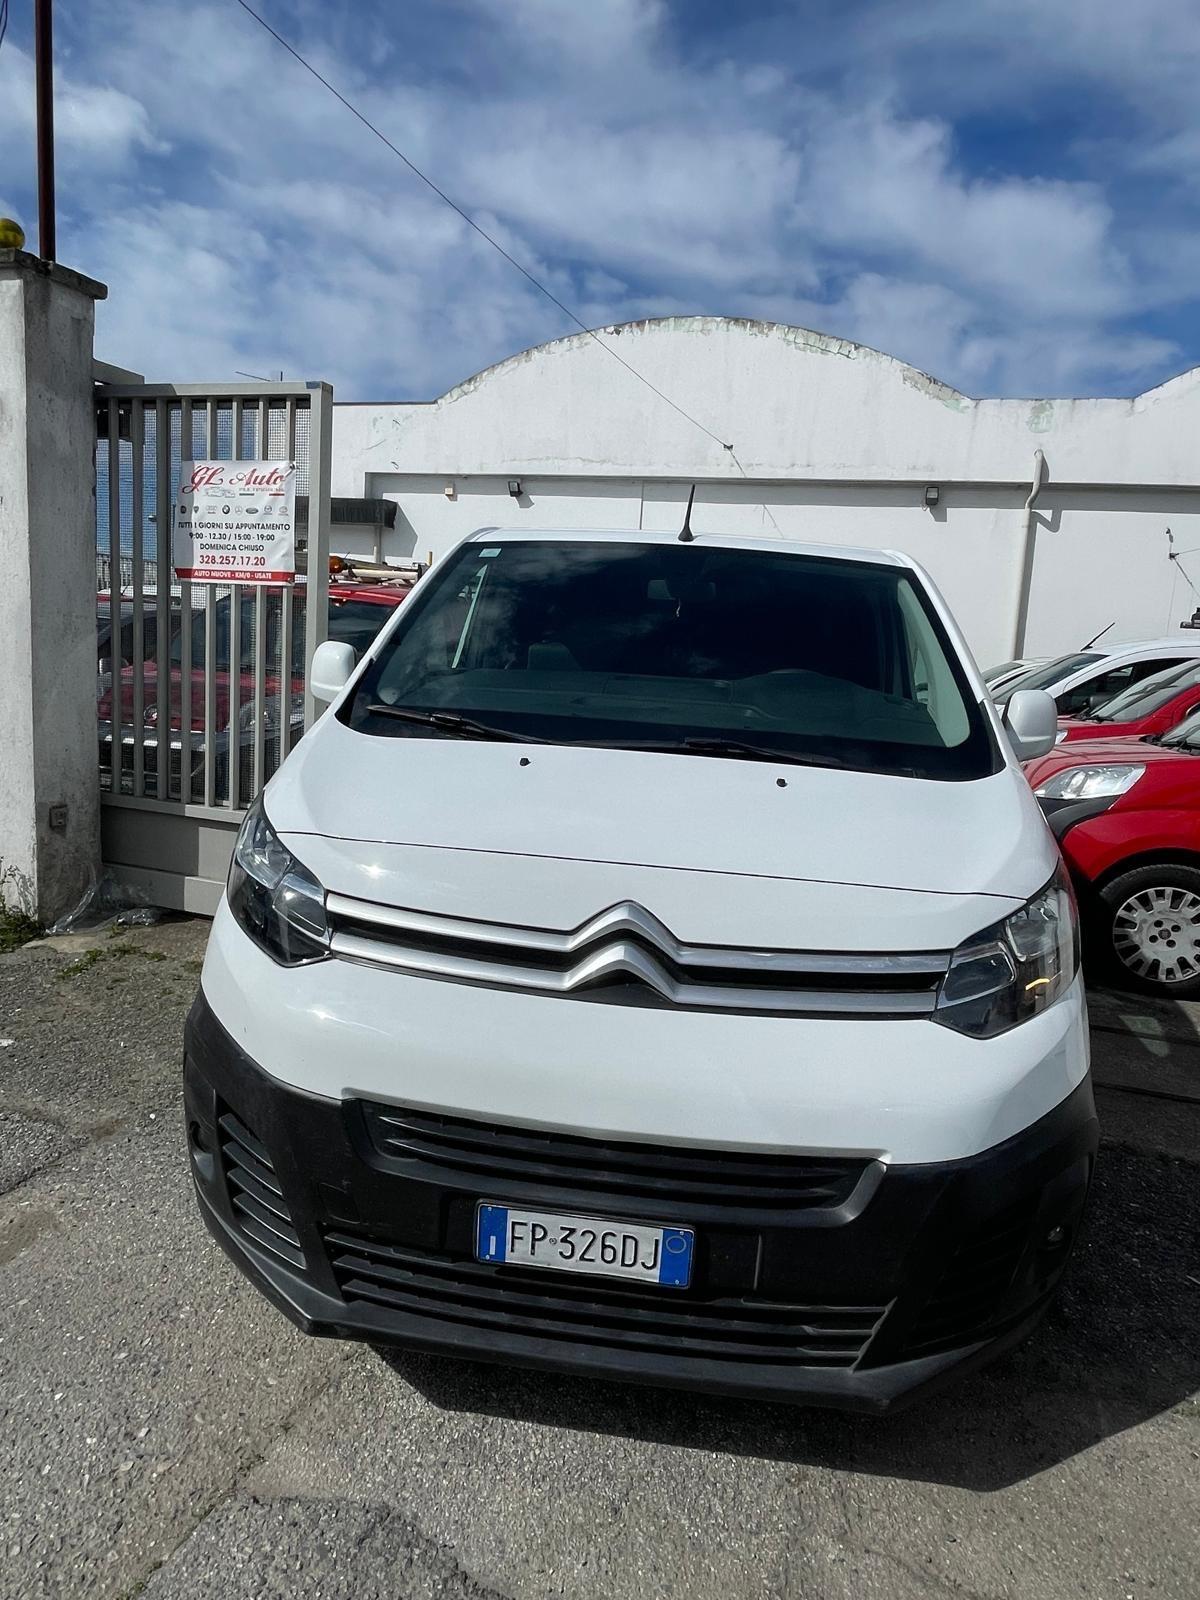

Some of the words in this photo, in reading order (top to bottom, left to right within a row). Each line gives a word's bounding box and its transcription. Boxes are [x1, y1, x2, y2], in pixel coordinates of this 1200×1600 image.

[182, 465, 224, 494] GL
[229, 468, 285, 486] Auto
[200, 555, 265, 566] 328.257.17.20
